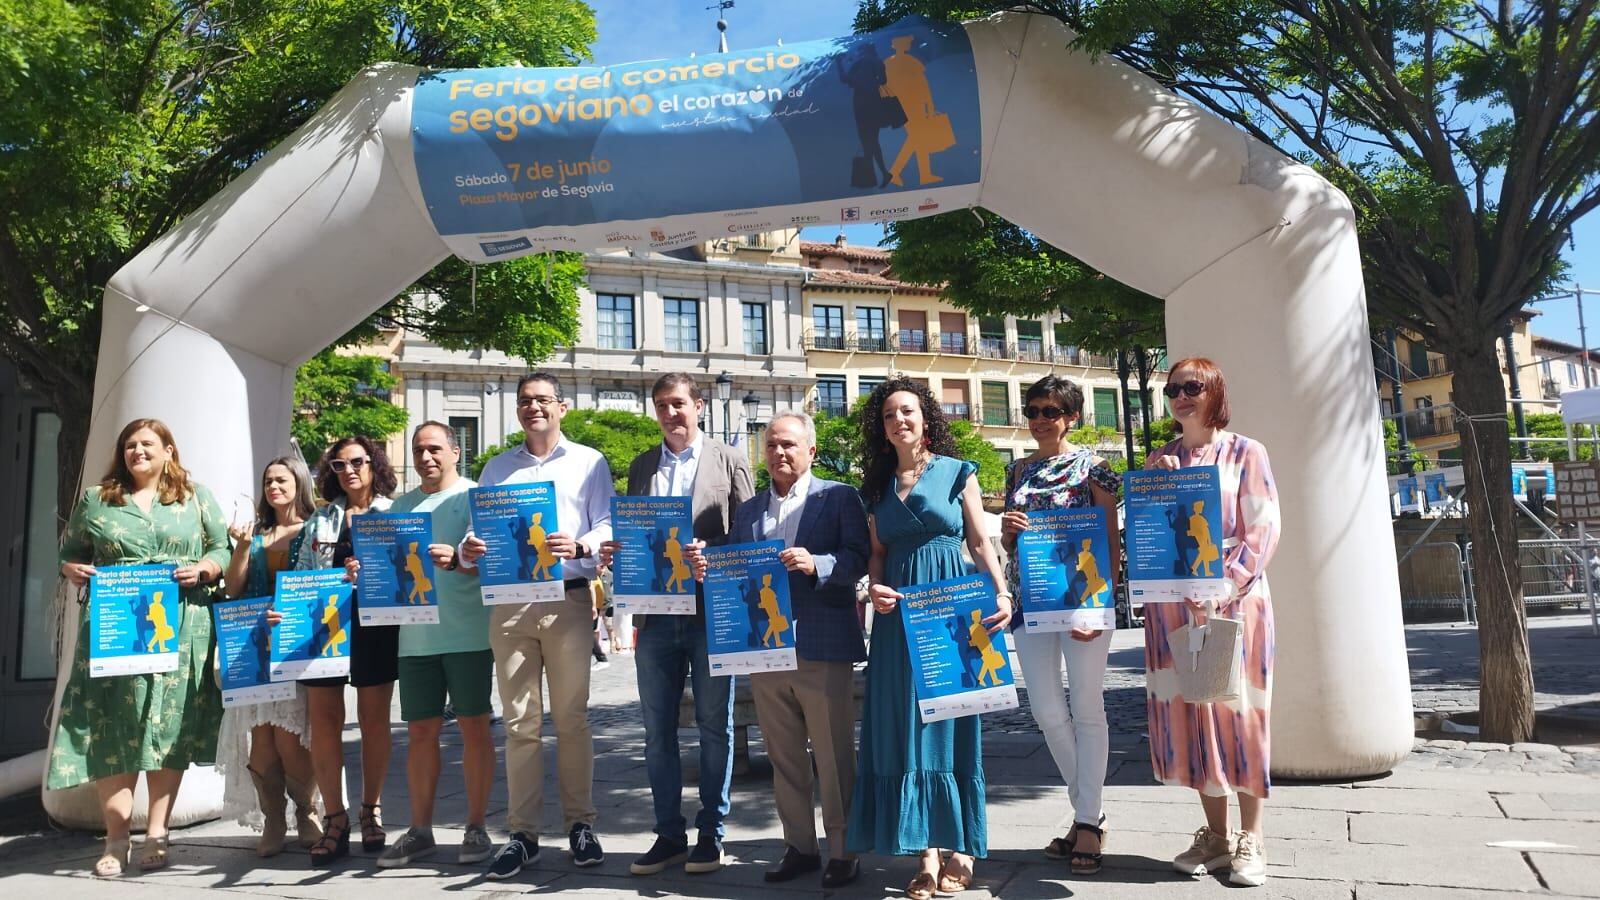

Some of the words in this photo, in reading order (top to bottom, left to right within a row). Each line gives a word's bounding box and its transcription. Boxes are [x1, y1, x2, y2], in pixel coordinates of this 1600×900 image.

[449, 77, 546, 100] Feria
[554, 71, 611, 92] del
[622, 53, 800, 86] comercio
[449, 94, 653, 142] segoviano
[658, 94, 679, 113] el
[788, 88, 803, 98] de
[749, 102, 820, 119] ciudad
[455, 173, 507, 187] Sábado
[507, 163, 521, 182] 7
[526, 161, 553, 180] de
[558, 156, 612, 184] junio
[459, 194, 497, 206] Plaza
[497, 190, 539, 204] Mayor
[541, 187, 558, 198] de
[561, 182, 614, 198] Segovia
[604, 391, 632, 400] PLAZA
[1130, 476, 1151, 484] Feria
[1168, 471, 1211, 481] comercio
[475, 491, 495, 499] Feria
[509, 487, 548, 496] comercio
[1130, 483, 1176, 493] segoviano
[476, 498, 517, 508] segoviano
[616, 509, 656, 518] segoviano
[1059, 512, 1097, 521] comercio
[389, 516, 424, 525] comercio
[705, 552, 726, 560] Feria
[740, 546, 777, 556] comercio
[132, 568, 170, 576] comercio
[281, 582, 320, 592] segoviano
[905, 590, 928, 600] Feria
[929, 587, 942, 596] del
[943, 579, 984, 593] comercio
[907, 594, 952, 609] segoviano
[939, 606, 955, 616] junio
